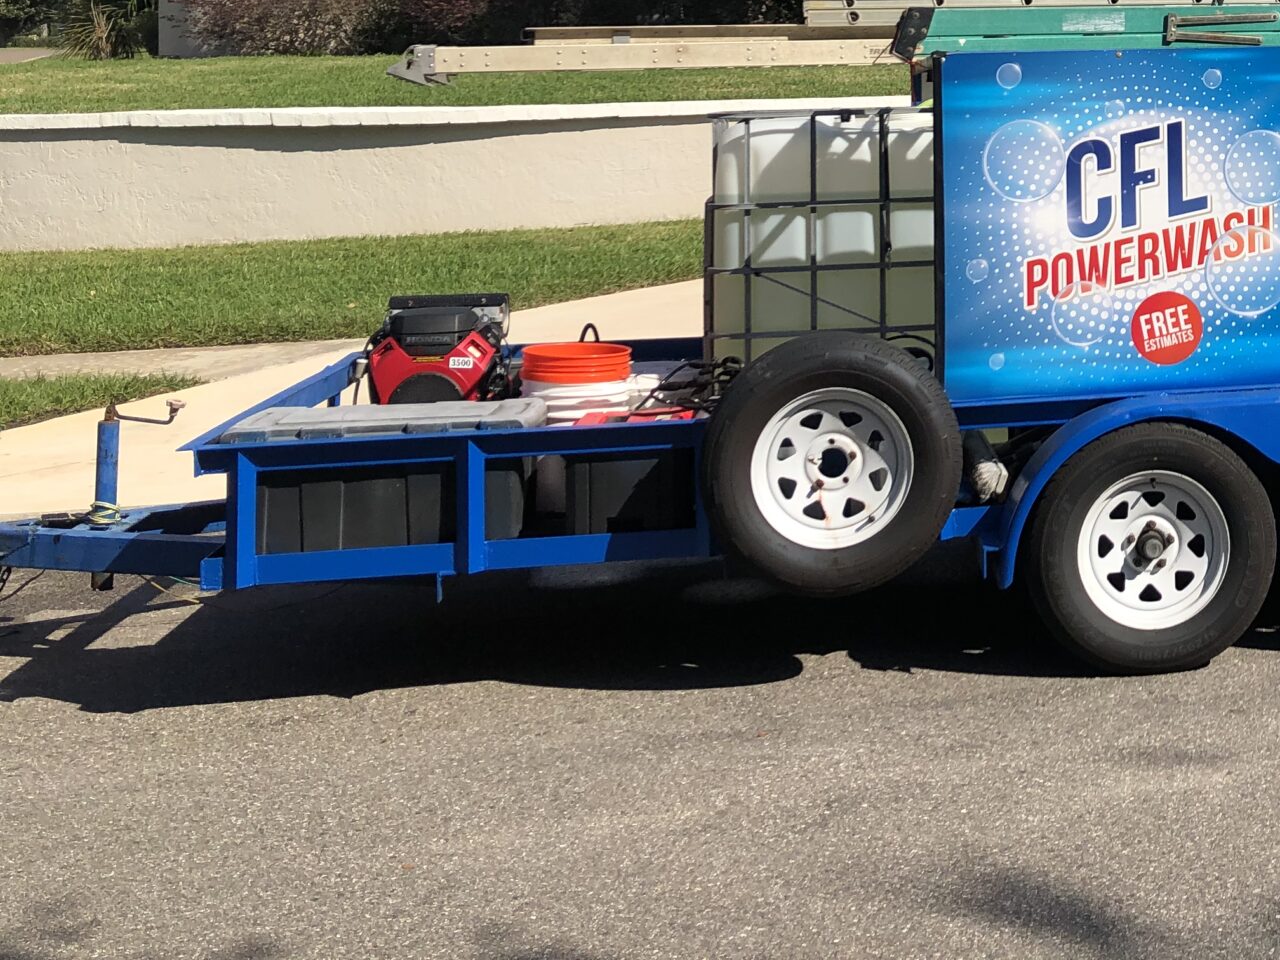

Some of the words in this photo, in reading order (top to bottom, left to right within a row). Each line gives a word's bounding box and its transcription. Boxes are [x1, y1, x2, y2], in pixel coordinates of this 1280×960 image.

[1066, 121, 1208, 239] CFL
[1025, 206, 1274, 309] POWERWASH
[1139, 305, 1192, 340] FREE
[1144, 330, 1194, 353] ESTIMATES
[451, 358, 471, 367] 3500
